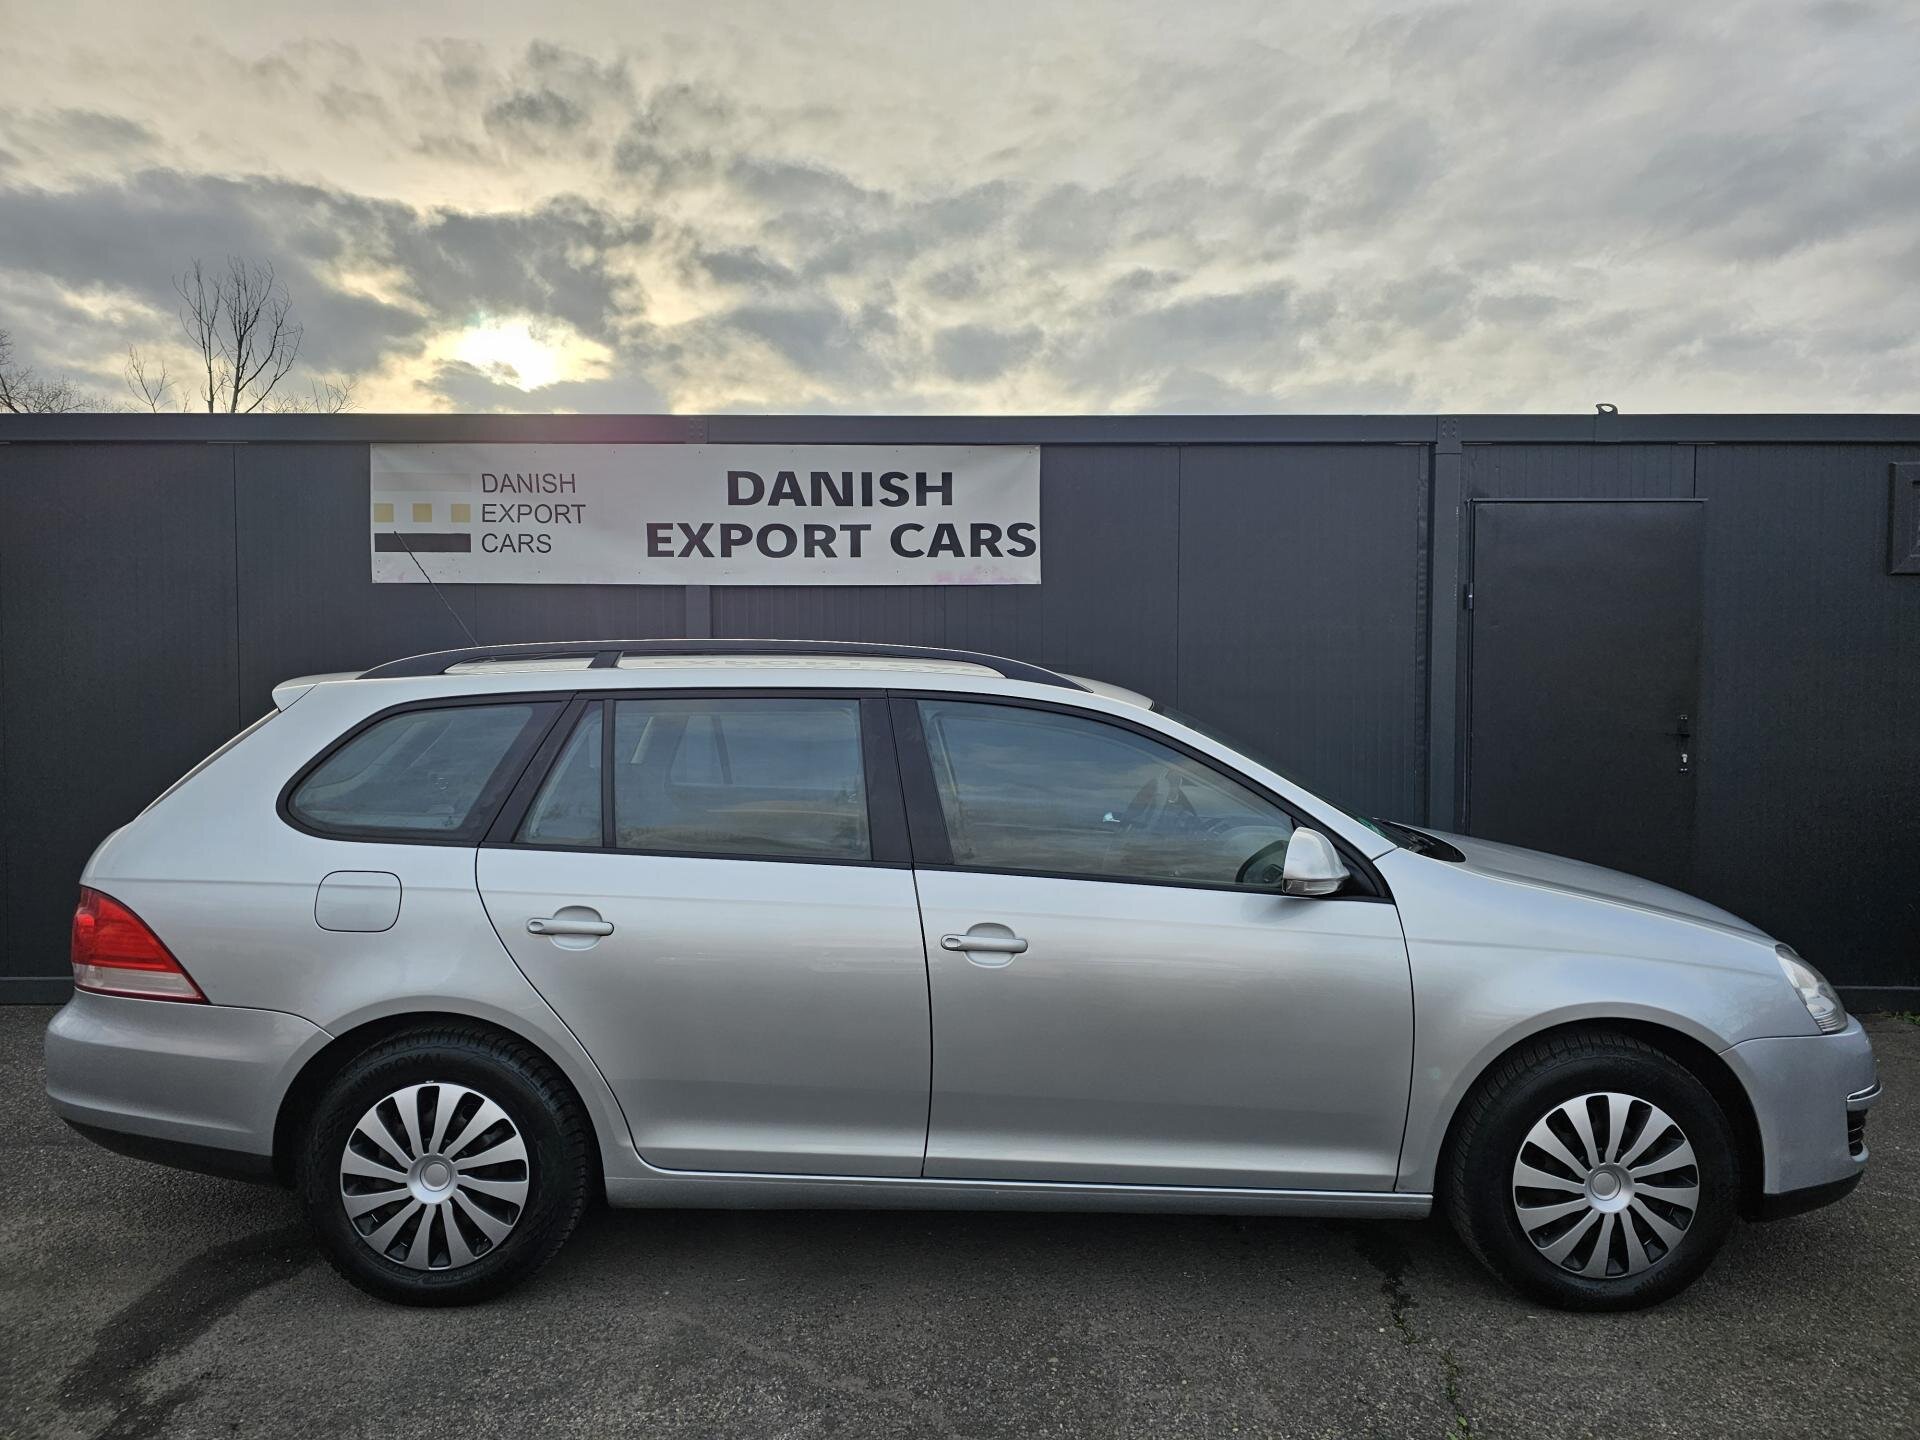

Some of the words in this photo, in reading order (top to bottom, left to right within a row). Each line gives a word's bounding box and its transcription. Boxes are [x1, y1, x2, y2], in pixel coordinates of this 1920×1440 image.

[481, 473, 576, 494] DANISH
[727, 471, 953, 507] DANISH
[481, 503, 587, 524] EXPORT
[481, 532, 552, 554] CARS
[646, 522, 871, 559] EXPORT
[889, 522, 1038, 559] CARS
